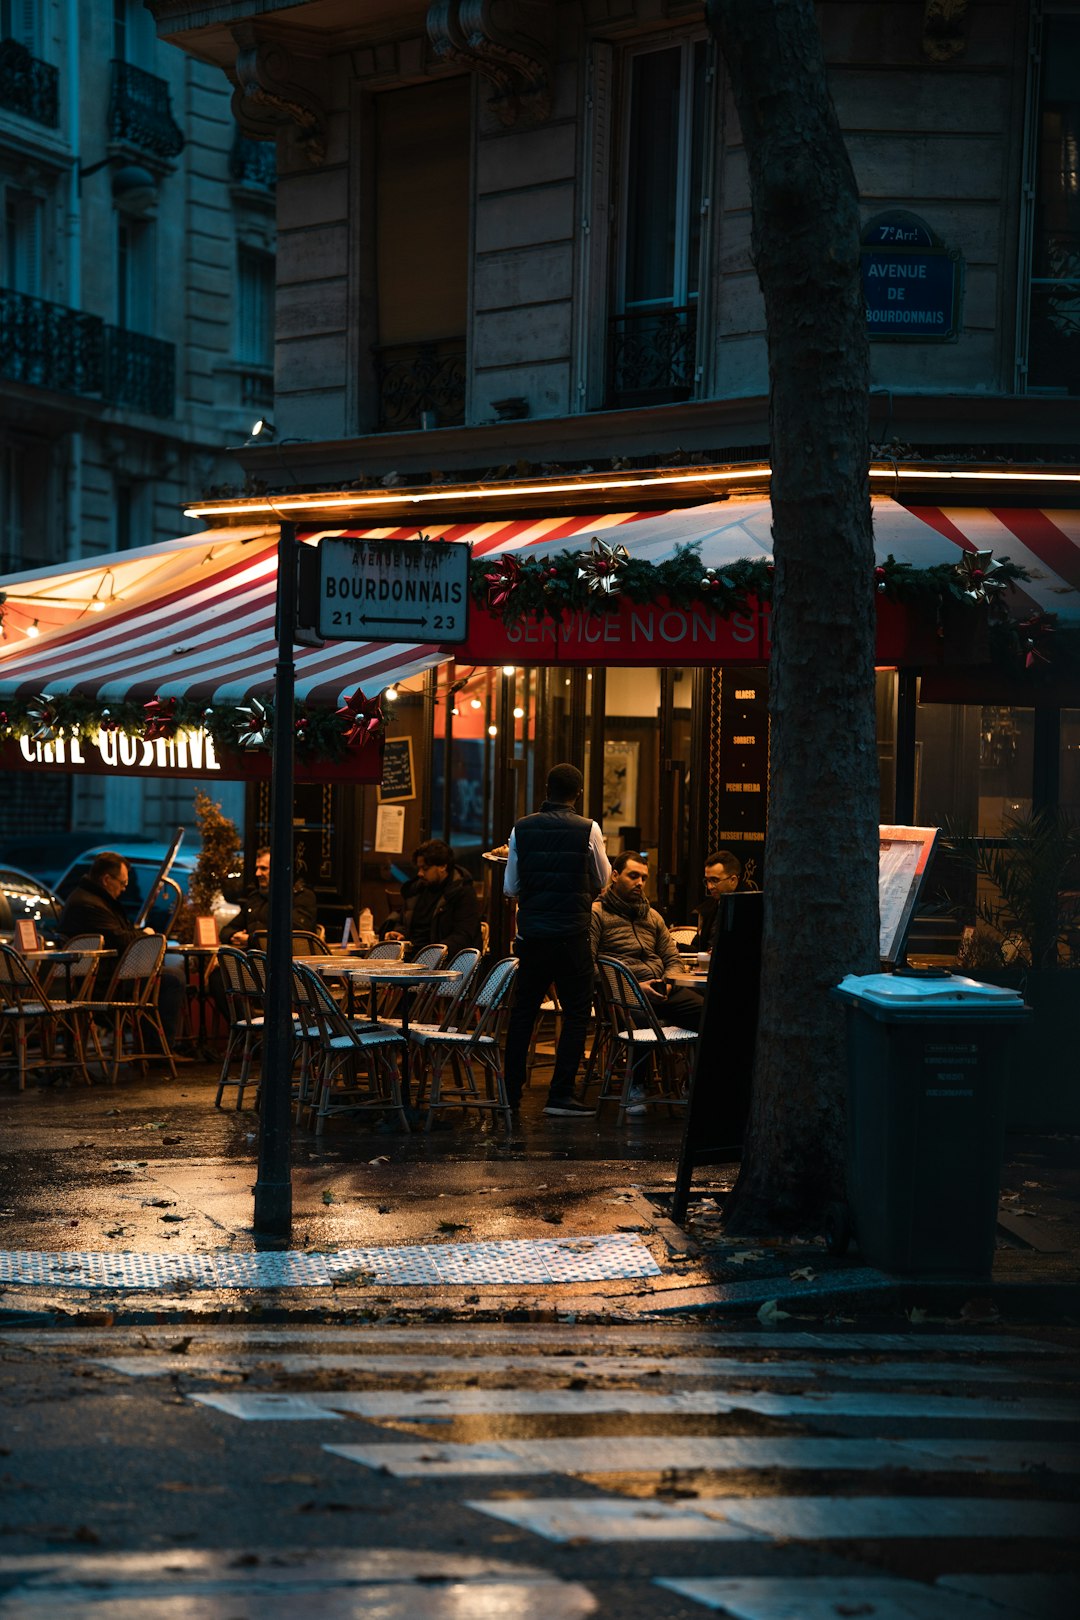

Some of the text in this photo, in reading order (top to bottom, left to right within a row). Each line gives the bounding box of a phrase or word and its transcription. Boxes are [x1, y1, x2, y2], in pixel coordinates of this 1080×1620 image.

[868, 264, 927, 278] AVENUE
[887, 287, 905, 300] DE
[866, 309, 944, 324] BOURDONNAIS
[352, 552, 399, 568] AVENUE
[405, 555, 419, 568] DE
[425, 555, 438, 569] LA
[326, 577, 462, 603] BOURDONNAIS
[332, 611, 455, 629] 21 23
[506, 611, 621, 643] SERVICE
[631, 611, 717, 642] NON
